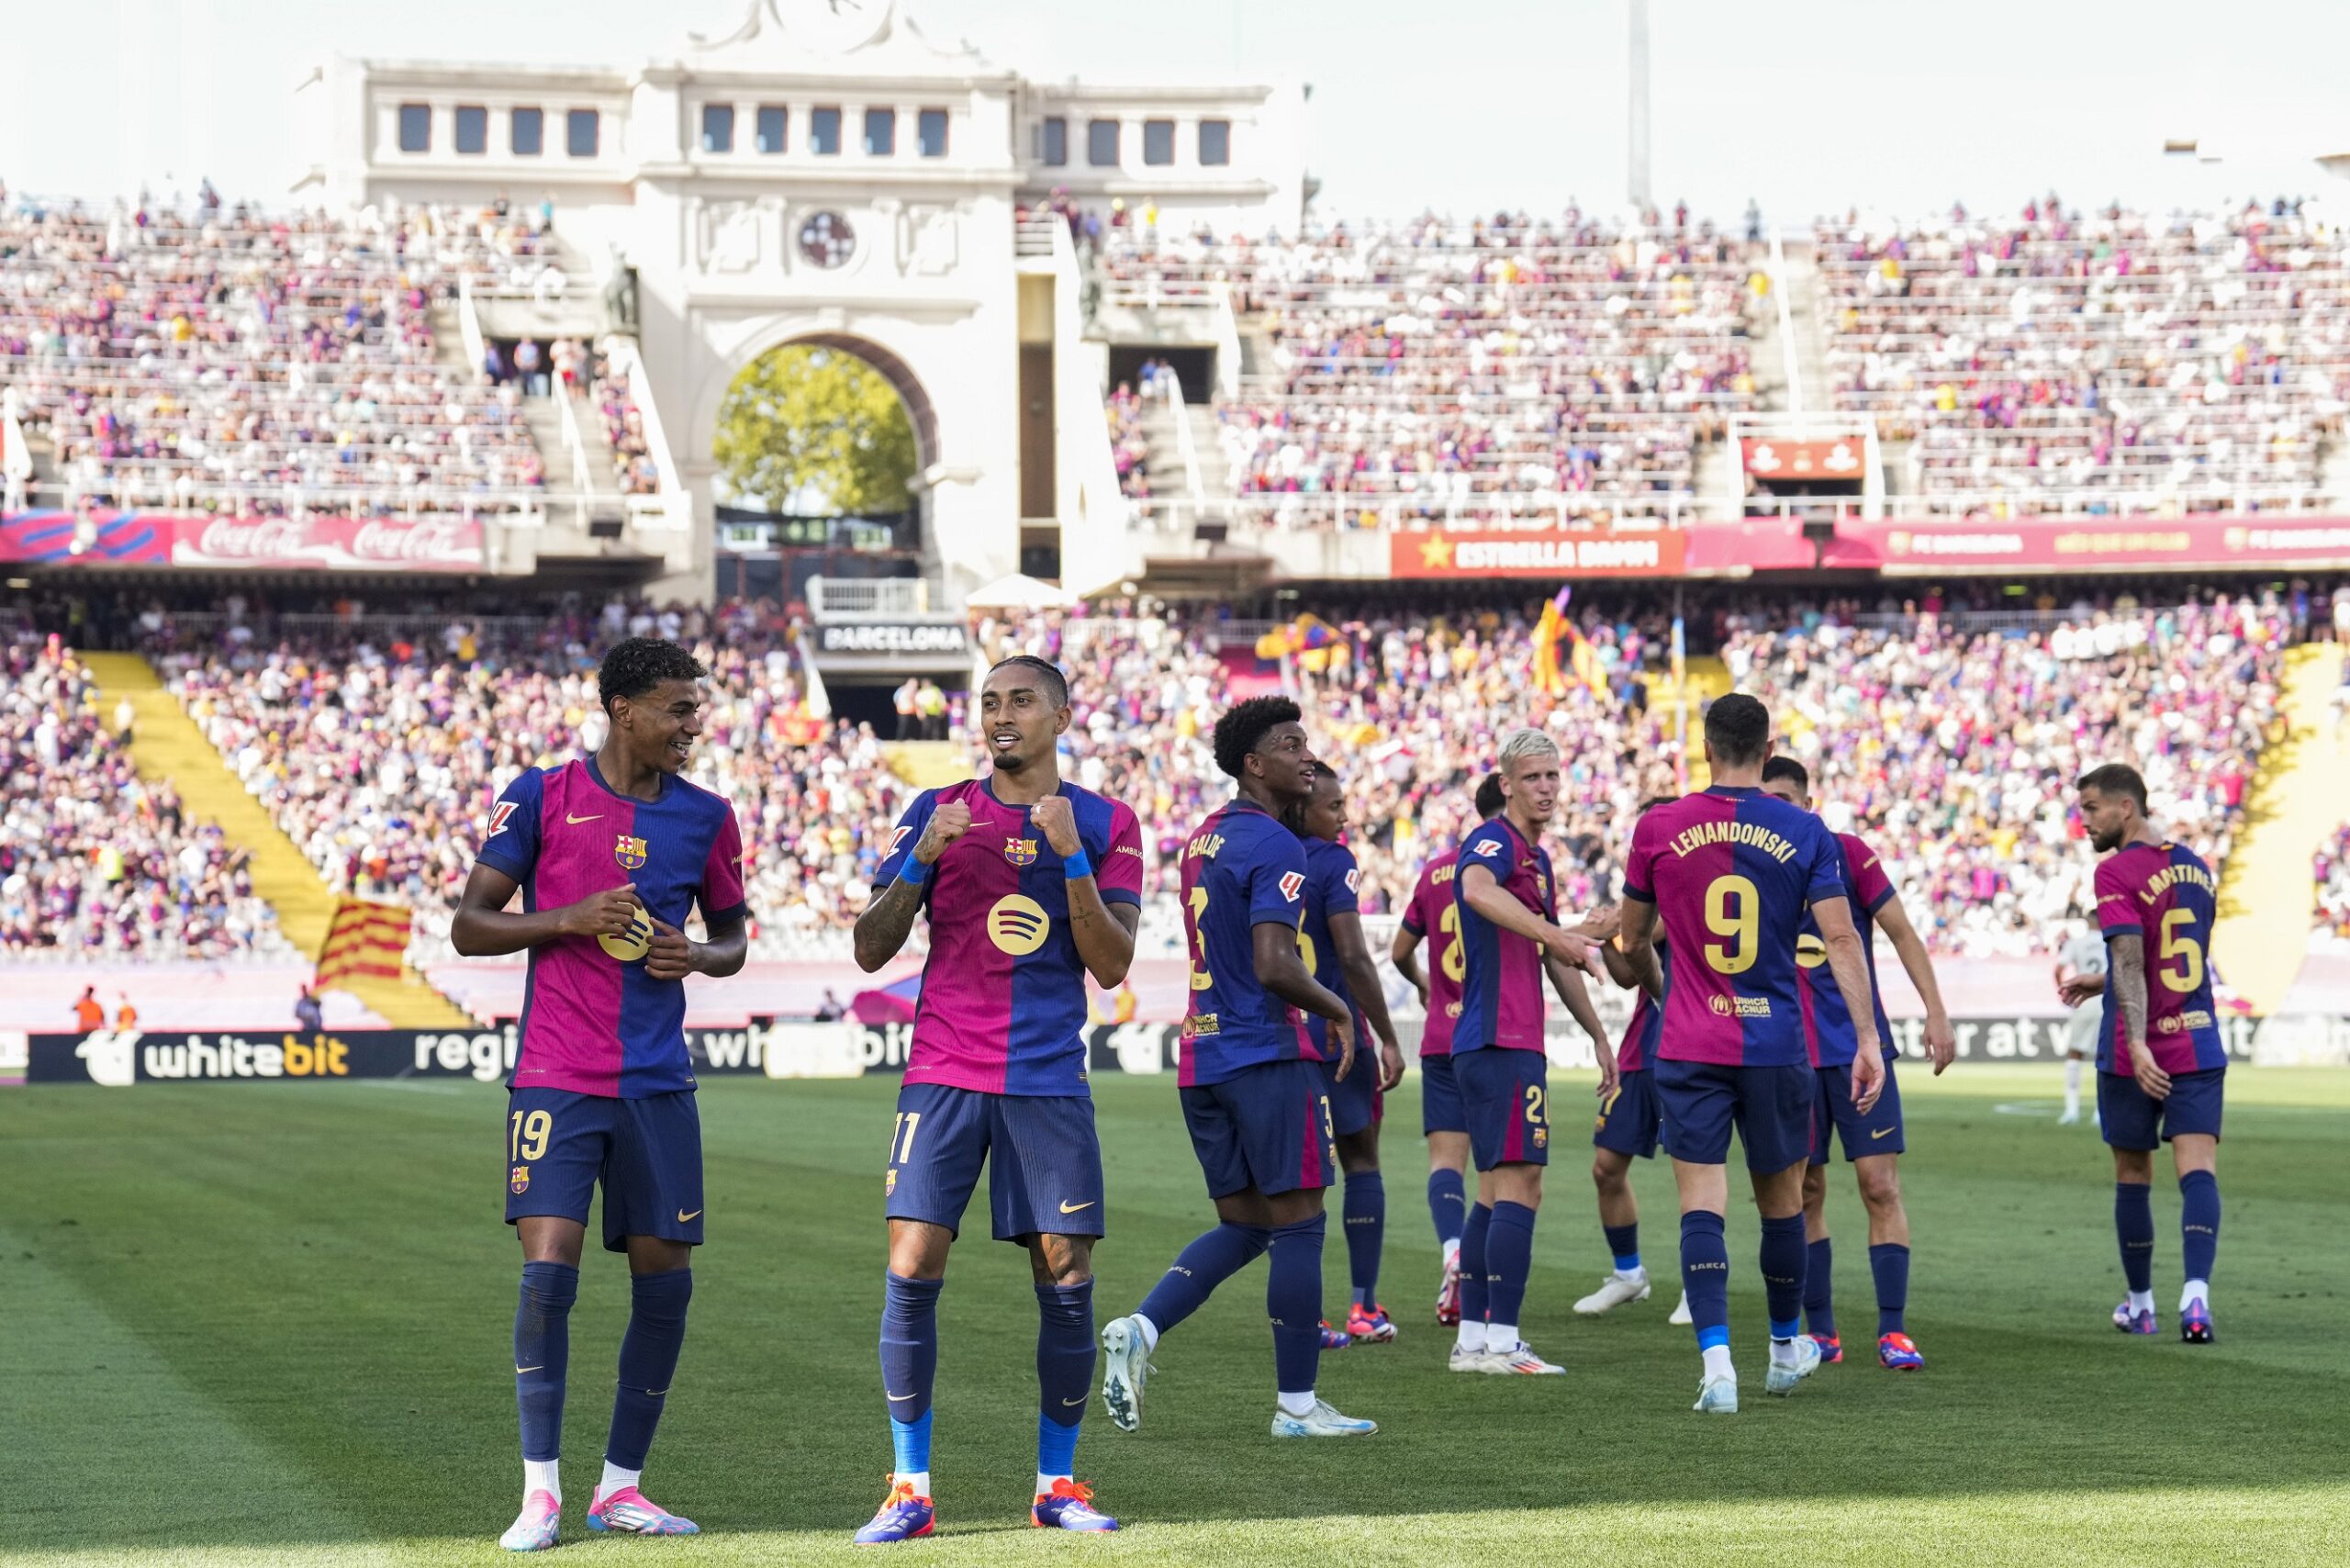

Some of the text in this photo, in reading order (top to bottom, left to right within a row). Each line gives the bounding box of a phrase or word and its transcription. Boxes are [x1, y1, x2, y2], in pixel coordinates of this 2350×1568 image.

[824, 625, 965, 651] BARCELONA
[1669, 821, 1797, 864] LEWANDOWSKI
[1705, 875, 1760, 975] 9
[2160, 908, 2203, 992] 5
[145, 1035, 348, 1078] whitebit
[415, 1025, 519, 1081] regi
[1986, 1015, 2040, 1058] at
[511, 1110, 552, 1161] 19
[890, 1113, 921, 1164] 11
